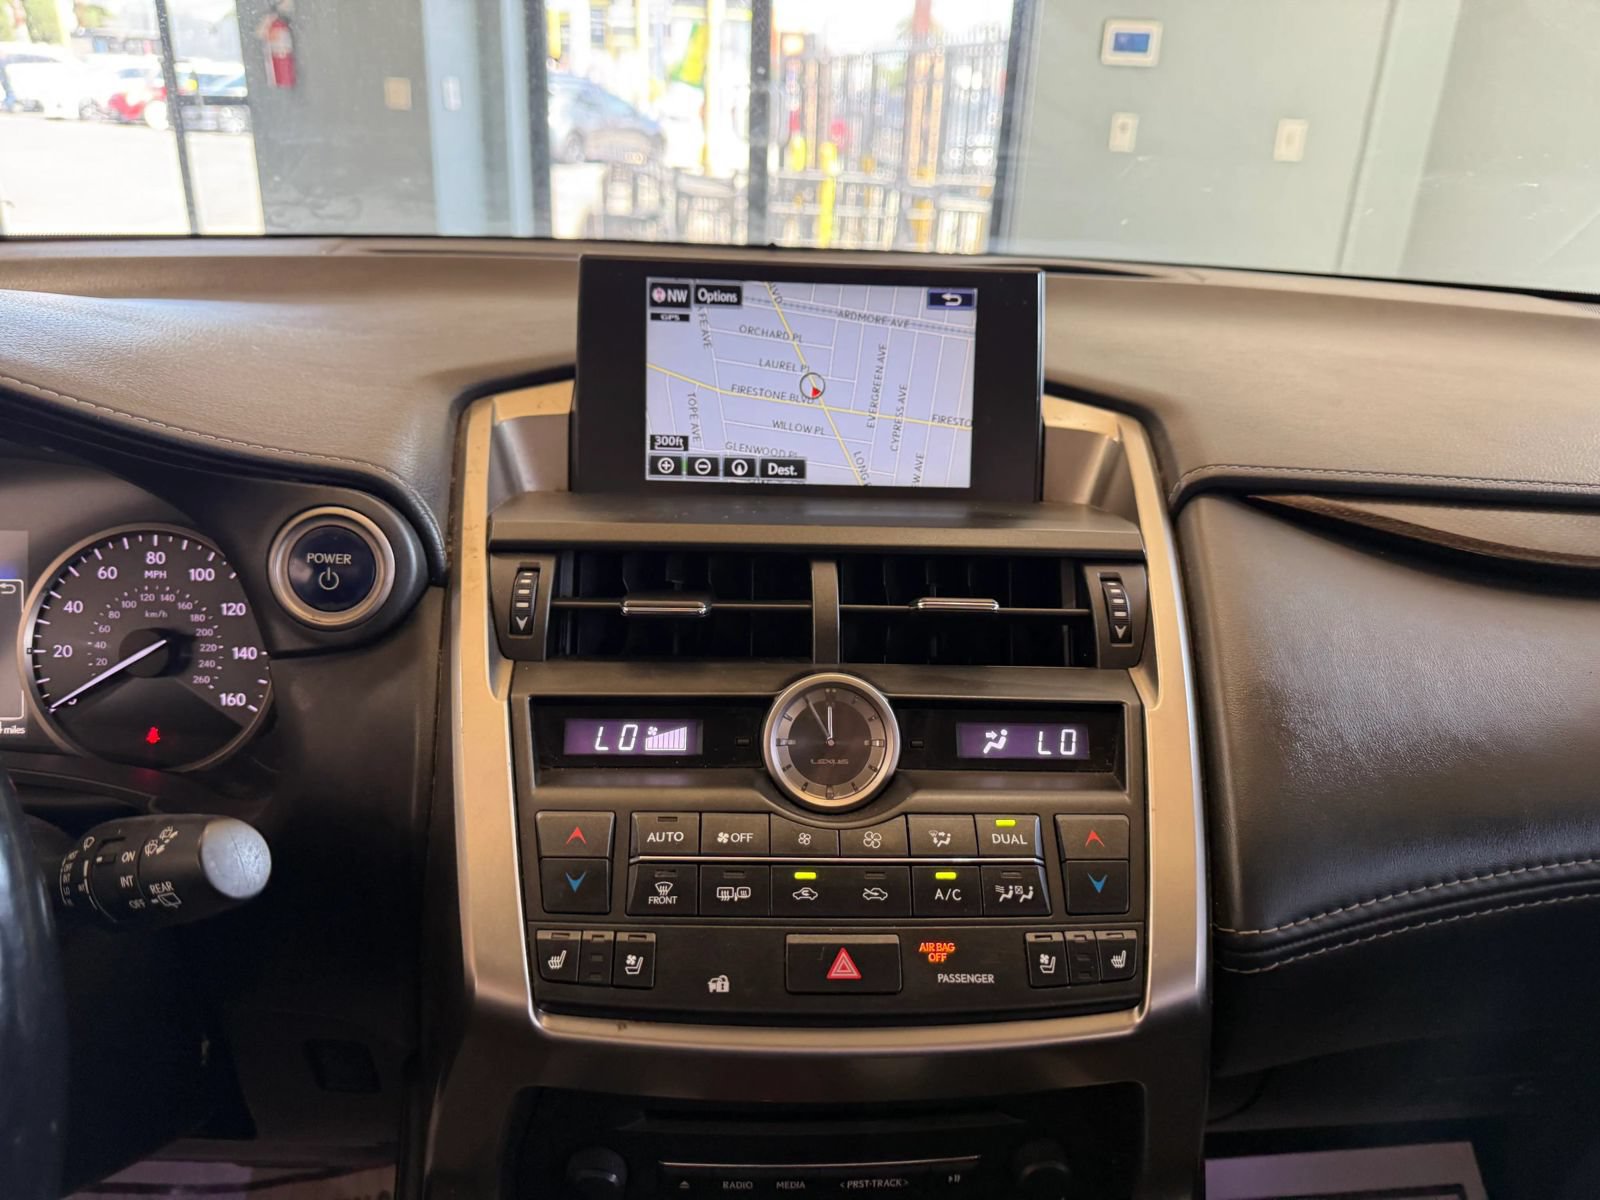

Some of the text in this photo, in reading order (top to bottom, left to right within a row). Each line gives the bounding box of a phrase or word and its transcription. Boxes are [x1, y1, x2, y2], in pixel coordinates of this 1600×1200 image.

[667, 288, 688, 303] NW
[697, 287, 738, 304] Options
[837, 310, 910, 329] ARDMORE AVE
[739, 324, 790, 341] ORCHARD
[759, 358, 797, 372] LAUREL
[731, 383, 787, 400] FIRESTONE
[866, 343, 888, 429] EVERGREEN AVE
[687, 392, 700, 443] TOPE AVE
[890, 384, 908, 452] CYPRESS AVE
[772, 420, 825, 436] WILLOW PL
[655, 436, 684, 446] 300ft
[725, 441, 787, 457] GLENWOOD
[768, 462, 798, 476] Dest.
[853, 451, 870, 481] LONG
[915, 452, 925, 473] AVE
[146, 551, 166, 565] 80
[306, 552, 352, 566] POWER
[97, 566, 118, 580] 60
[144, 570, 167, 579] MPH
[189, 568, 216, 582] 100
[140, 593, 155, 602] 120
[160, 593, 176, 602] 140
[63, 600, 84, 614] 40
[121, 600, 137, 609] 100
[177, 601, 193, 610] 160
[221, 602, 246, 616] 120
[108, 611, 120, 619] 80
[144, 610, 168, 618] km/h
[190, 614, 206, 622] 180
[98, 625, 111, 633] 60
[195, 628, 214, 636] 200
[53, 645, 73, 658] 20
[94, 641, 107, 649] 40
[200, 643, 217, 652] 220
[231, 647, 257, 660] 140
[95, 657, 108, 666] 20
[198, 659, 216, 668] 240
[192, 675, 211, 684] 260
[220, 692, 246, 707] 160
[3, 724, 26, 735] miles
[594, 724, 639, 751] LO
[1037, 728, 1077, 756] LO
[646, 831, 685, 843] AUTO
[730, 832, 754, 843] OFF
[991, 833, 1028, 845] DUAL
[121, 850, 136, 863] ON
[120, 875, 134, 888] INT
[149, 880, 175, 895] REAR
[648, 896, 678, 905] FRONT
[934, 888, 962, 901] A/C
[128, 899, 146, 909] OFF
[918, 942, 956, 953] AIR BAG
[928, 952, 948, 963] OFF
[937, 973, 995, 984] PASSENGER
[722, 1180, 753, 1190] RADIO
[775, 1181, 806, 1190] MEDIA
